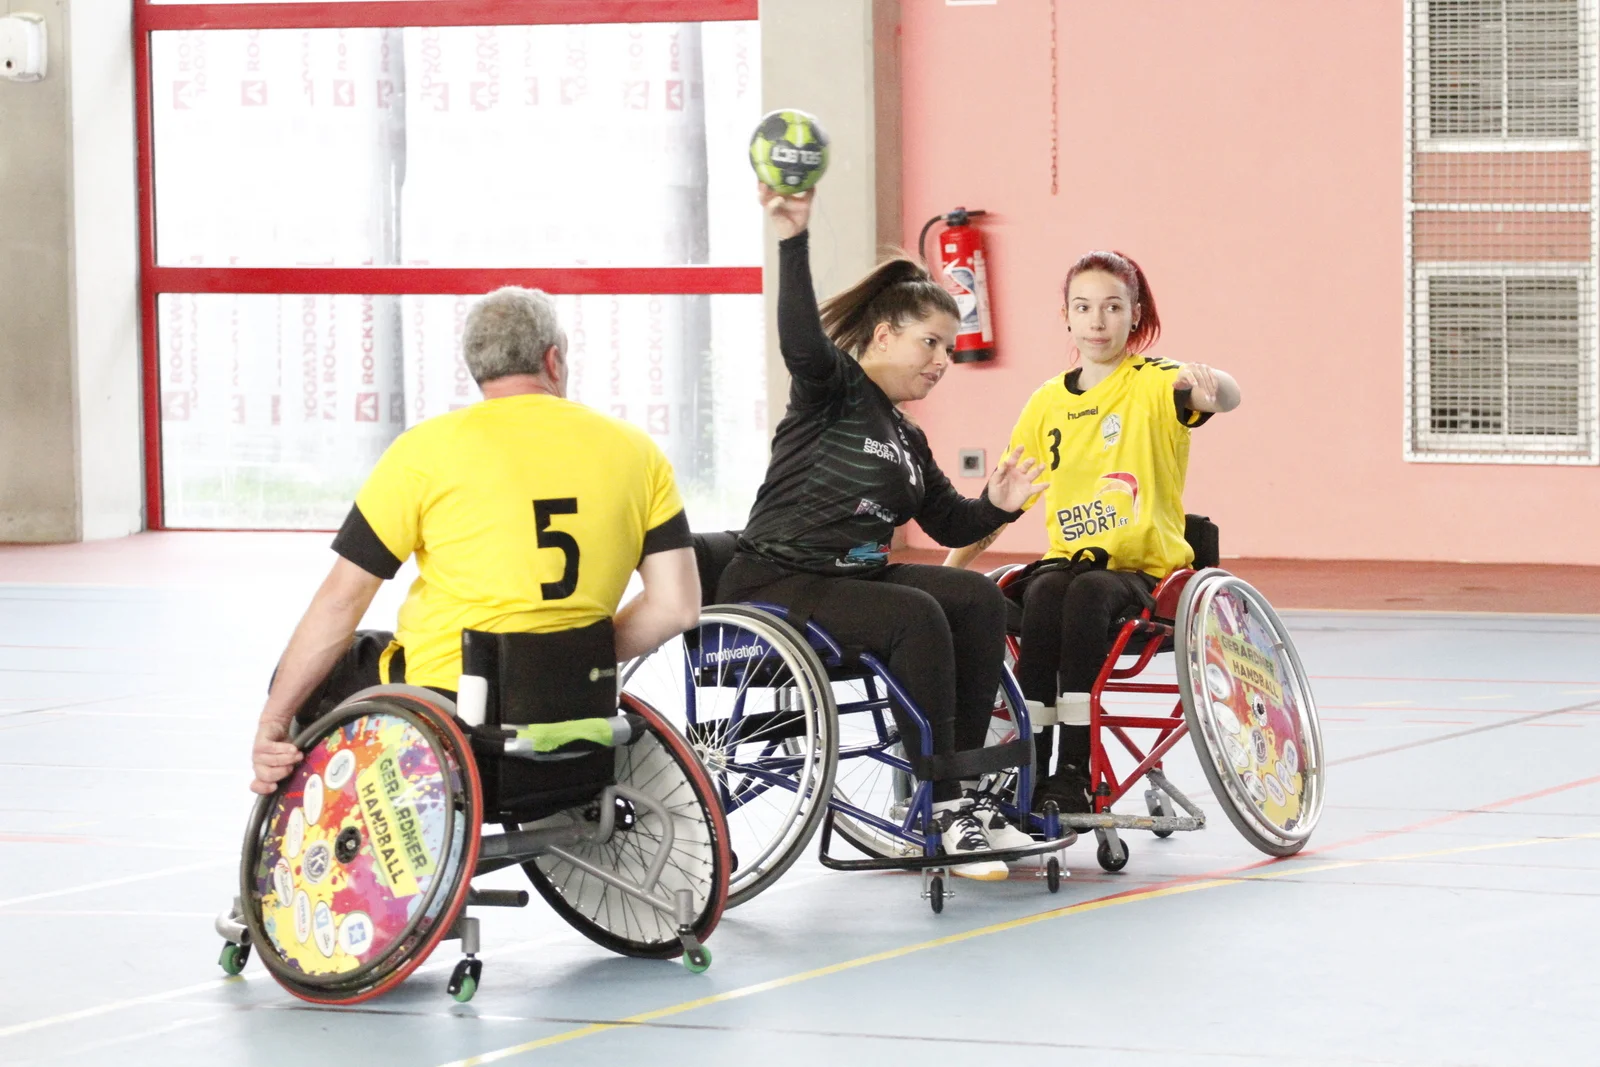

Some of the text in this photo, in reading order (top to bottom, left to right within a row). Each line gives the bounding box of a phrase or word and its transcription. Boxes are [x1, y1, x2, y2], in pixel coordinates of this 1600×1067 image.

[1066, 405, 1099, 420] hummel
[864, 437, 889, 454] PAYS
[1047, 427, 1062, 472] 3
[1056, 499, 1103, 527] PAYS
[532, 496, 581, 601] 5
[705, 644, 764, 664] motivation
[1232, 659, 1279, 699] HANDBALL
[361, 781, 405, 885] HANDBALL
